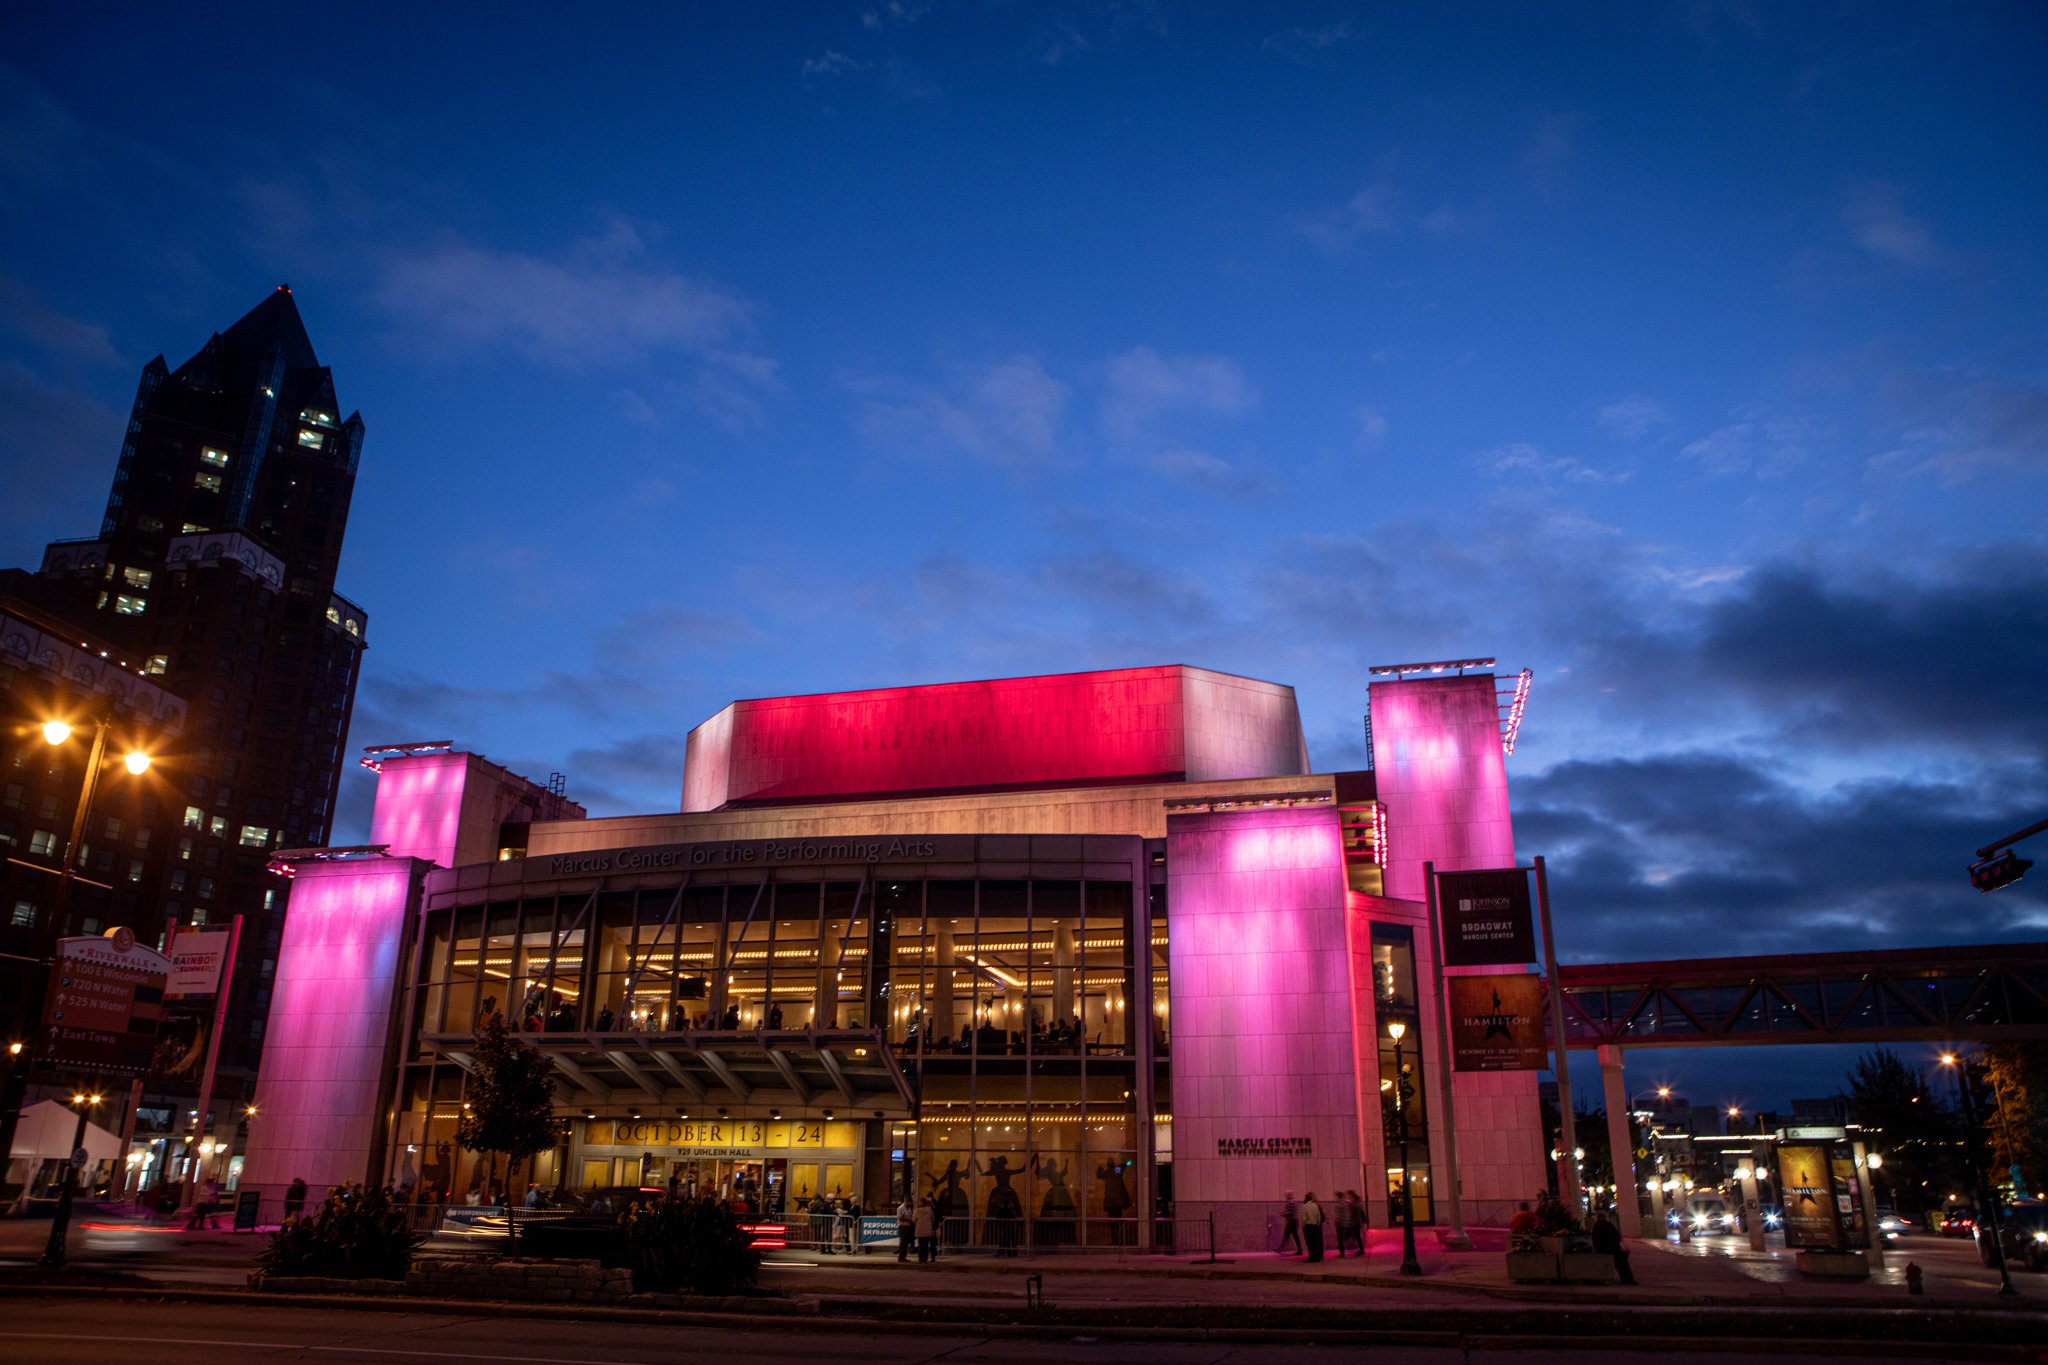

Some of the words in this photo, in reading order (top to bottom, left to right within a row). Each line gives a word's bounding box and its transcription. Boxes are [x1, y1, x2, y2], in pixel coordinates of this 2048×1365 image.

[551, 856, 609, 875] Marcus
[616, 848, 681, 868] Center
[687, 845, 716, 864] for
[722, 842, 755, 863] the
[763, 839, 881, 863] Performing
[888, 838, 936, 858] Arts
[1462, 921, 1513, 932] BROADWAY
[1463, 933, 1488, 941] MARCUS
[1490, 932, 1514, 940] CENTER
[87, 948, 149, 968] RIVERWALK
[172, 956, 219, 965] RAINBOW
[76, 964, 94, 976] 100
[95, 966, 103, 977] E
[72, 978, 92, 991] 720
[93, 983, 101, 992] N
[102, 984, 129, 995] Water
[68, 995, 88, 1007] 525
[89, 998, 98, 1008] N
[99, 999, 128, 1013] Water
[1464, 1016, 1530, 1026] HAMILTON
[62, 1028, 88, 1040] East
[88, 1031, 116, 1044] Town
[617, 1124, 723, 1142] OCTOBER
[739, 1125, 762, 1142] 13
[797, 1126, 821, 1143] 24
[1218, 1138, 1265, 1148] MARCUS
[1267, 1138, 1312, 1147] CENTER
[677, 1148, 691, 1156] 929
[693, 1148, 727, 1156] UIHLEIN
[729, 1148, 752, 1156] HALL
